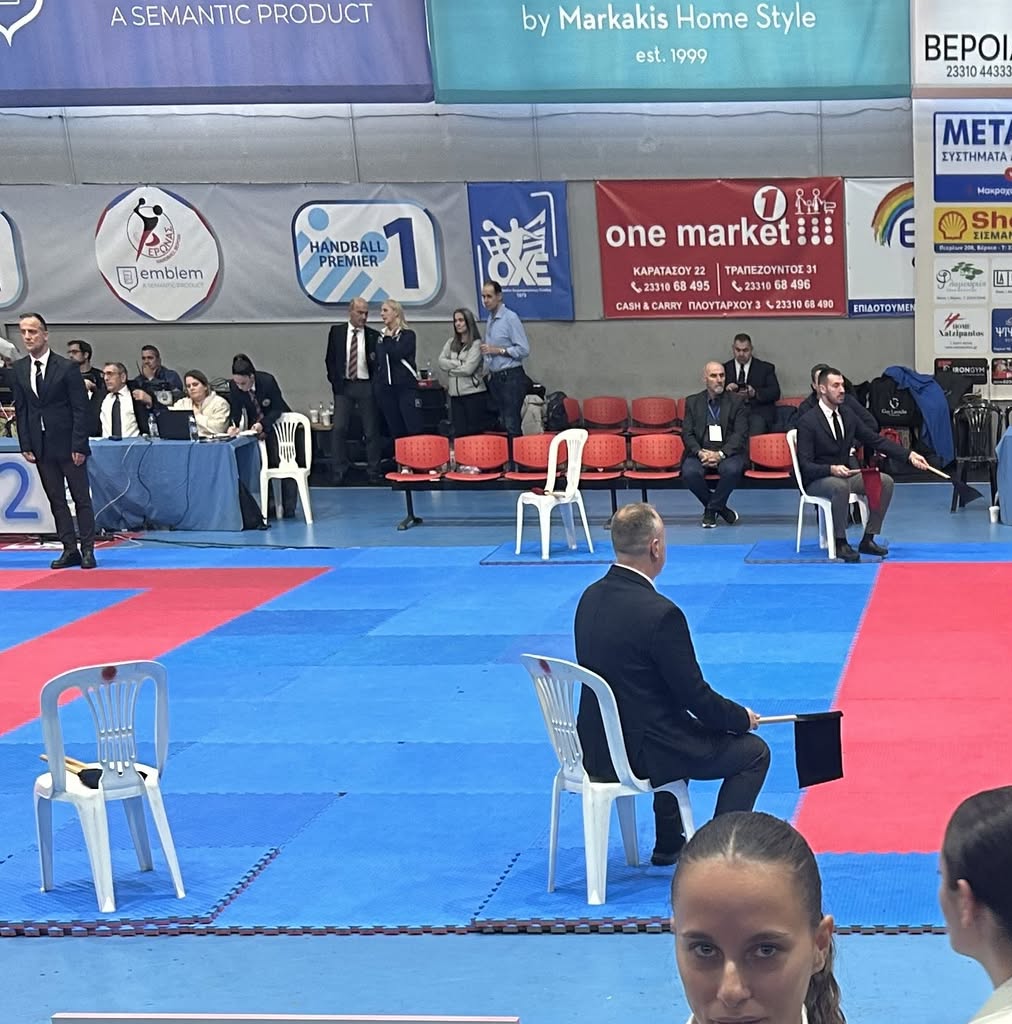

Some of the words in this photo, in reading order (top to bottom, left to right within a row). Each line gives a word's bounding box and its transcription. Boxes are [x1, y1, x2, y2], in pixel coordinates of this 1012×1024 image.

[110, 6, 127, 27] A
[132, 4, 252, 27] SEMANTIC
[258, 3, 374, 25] PRODUCT
[521, 7, 550, 36] by
[558, 4, 669, 31] Markakis
[677, 6, 749, 30] Home
[756, 2, 817, 35] Style
[635, 48, 666, 64] est.
[670, 48, 708, 65] 1999
[946, 65, 978, 78] 23310
[980, 64, 1012, 77] 44333
[942, 151, 1008, 163] ΣΥΣΤΗΜΑΤΑ
[606, 223, 667, 247] one
[677, 217, 790, 247] market
[309, 241, 385, 254] HANDBALL
[383, 217, 420, 290] 1
[319, 255, 379, 267] PREMIER
[140, 267, 204, 280] emblem
[633, 266, 692, 276] ΚΑΡΑΤΑΣΟΥ
[694, 266, 706, 275] 22
[725, 264, 804, 275] ΤΡΑΠΕΖΟΥΝΤΟΣ
[806, 264, 817, 274] 31
[644, 283, 671, 292] 23310
[673, 281, 687, 291] 68
[689, 280, 710, 291] 495
[745, 282, 771, 291] 23310
[774, 280, 788, 290] 68
[790, 279, 811, 290] 496
[616, 302, 641, 311] CASH
[643, 302, 650, 311] &
[652, 301, 682, 311] CARRY
[688, 301, 753, 311] ΠΛΟΥΤΑΡΧΟΥ
[755, 301, 761, 310] 3
[776, 300, 802, 310] 23310
[804, 300, 815, 309] 68
[817, 299, 834, 309] 490
